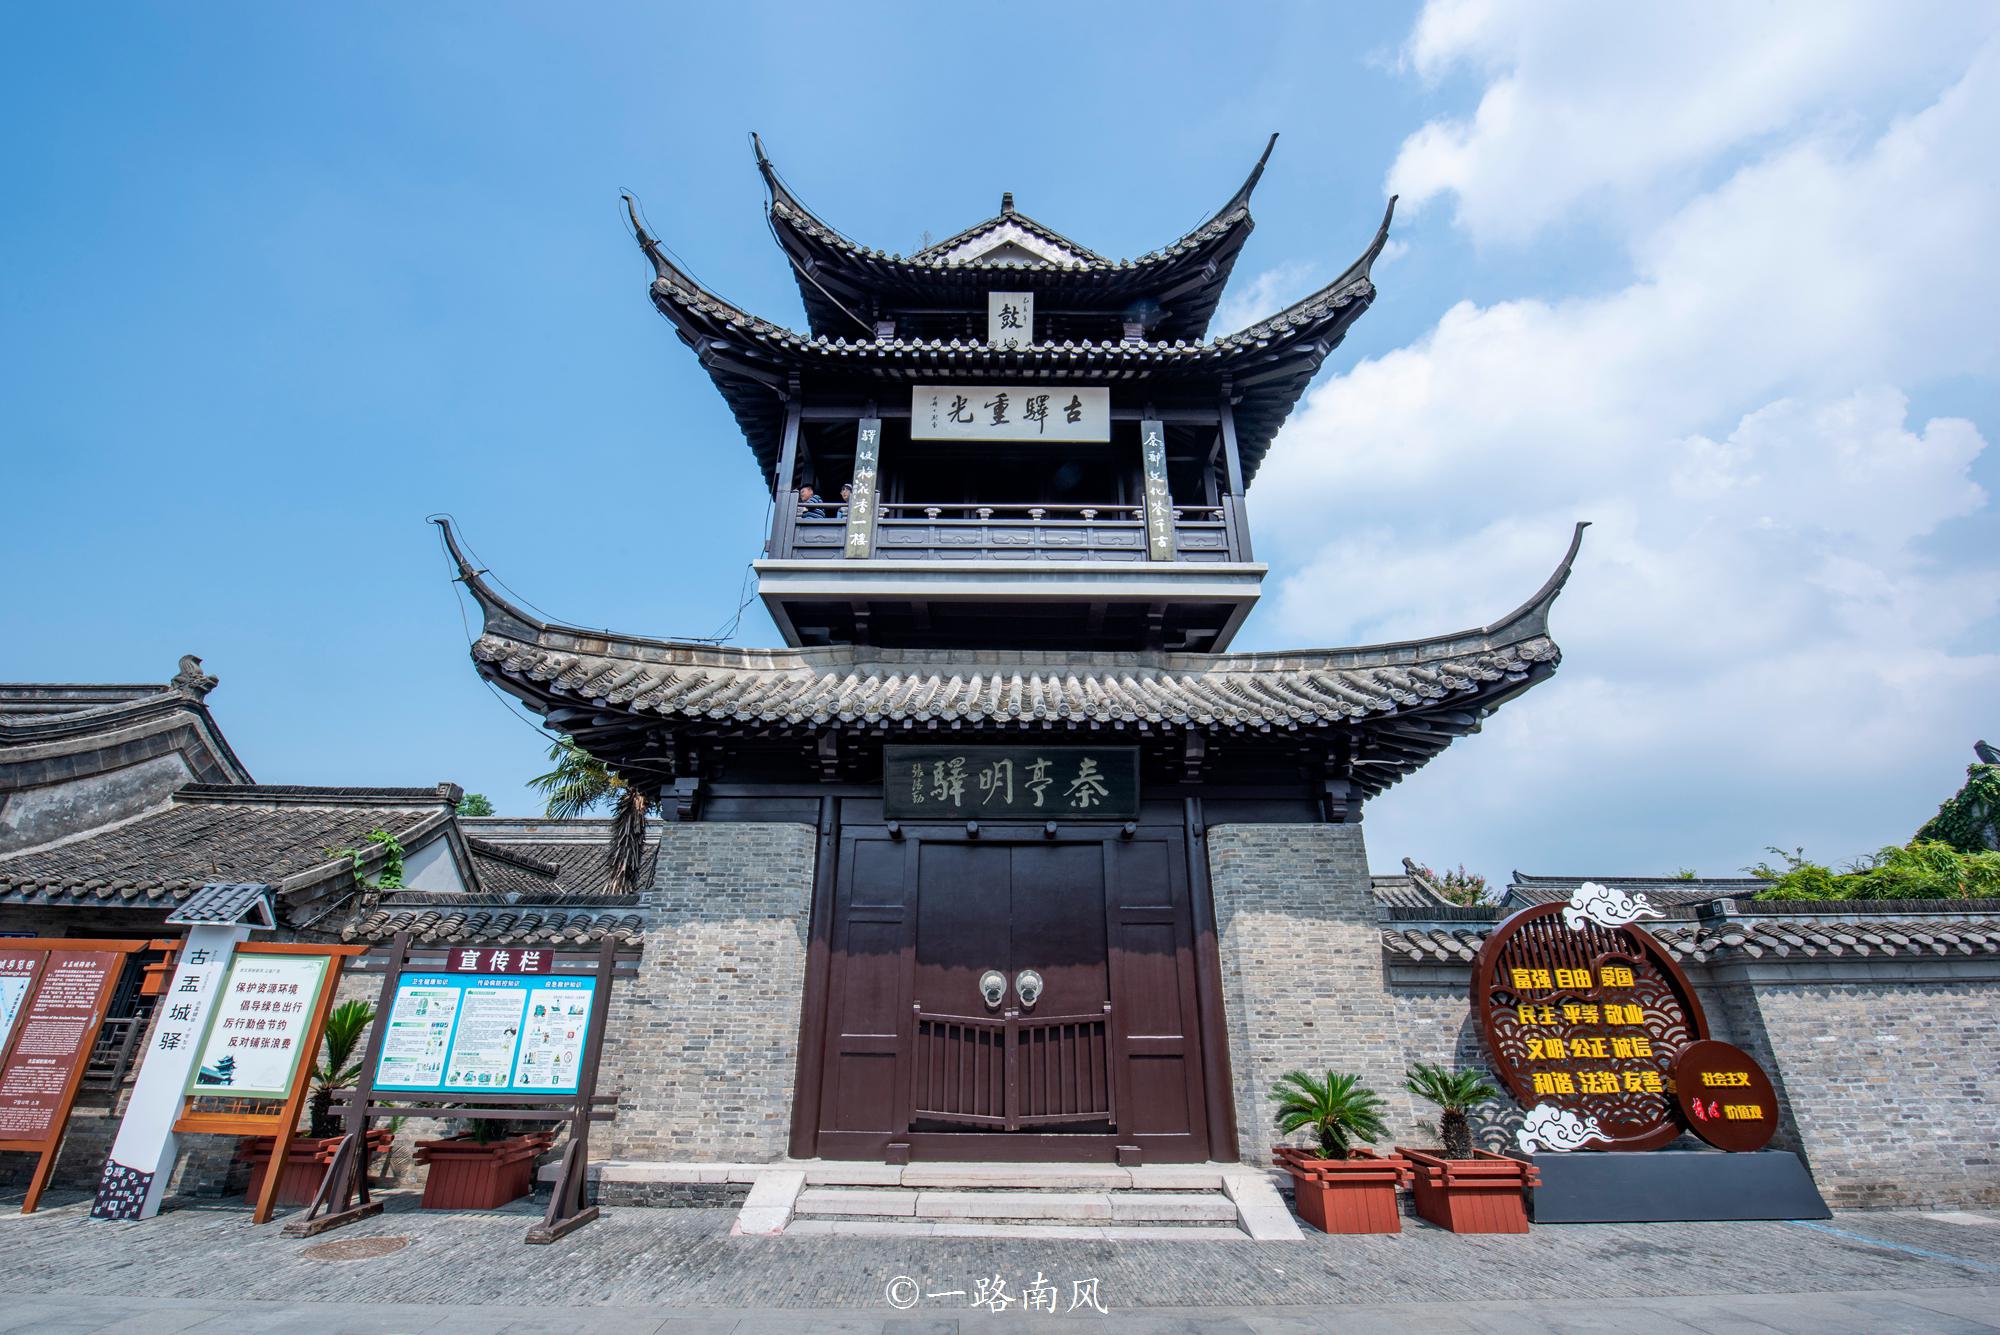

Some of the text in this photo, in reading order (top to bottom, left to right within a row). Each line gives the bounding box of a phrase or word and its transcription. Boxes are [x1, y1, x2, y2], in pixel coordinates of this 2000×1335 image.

[998, 303, 1023, 346] 鼓
[458, 950, 541, 972] 宣传栏
[1511, 966, 1635, 989] 富强 自由 爱国
[158, 948, 210, 1050] 古盂城驿
[236, 982, 299, 995] 保护资源环境
[240, 1000, 303, 1013] 倡导绿色出行
[1517, 1004, 1645, 1025] 民主 平等 敬业
[223, 1018, 287, 1031] 厉行勤俭节约
[228, 1036, 292, 1049] 反对铺张浪费
[1525, 1037, 1653, 1060] 文明 公正 诚信
[1532, 1070, 1664, 1094] 和谐 法治 友善
[1701, 1072, 1752, 1087] 社会主义
[1723, 1105, 1764, 1120] 价值观
